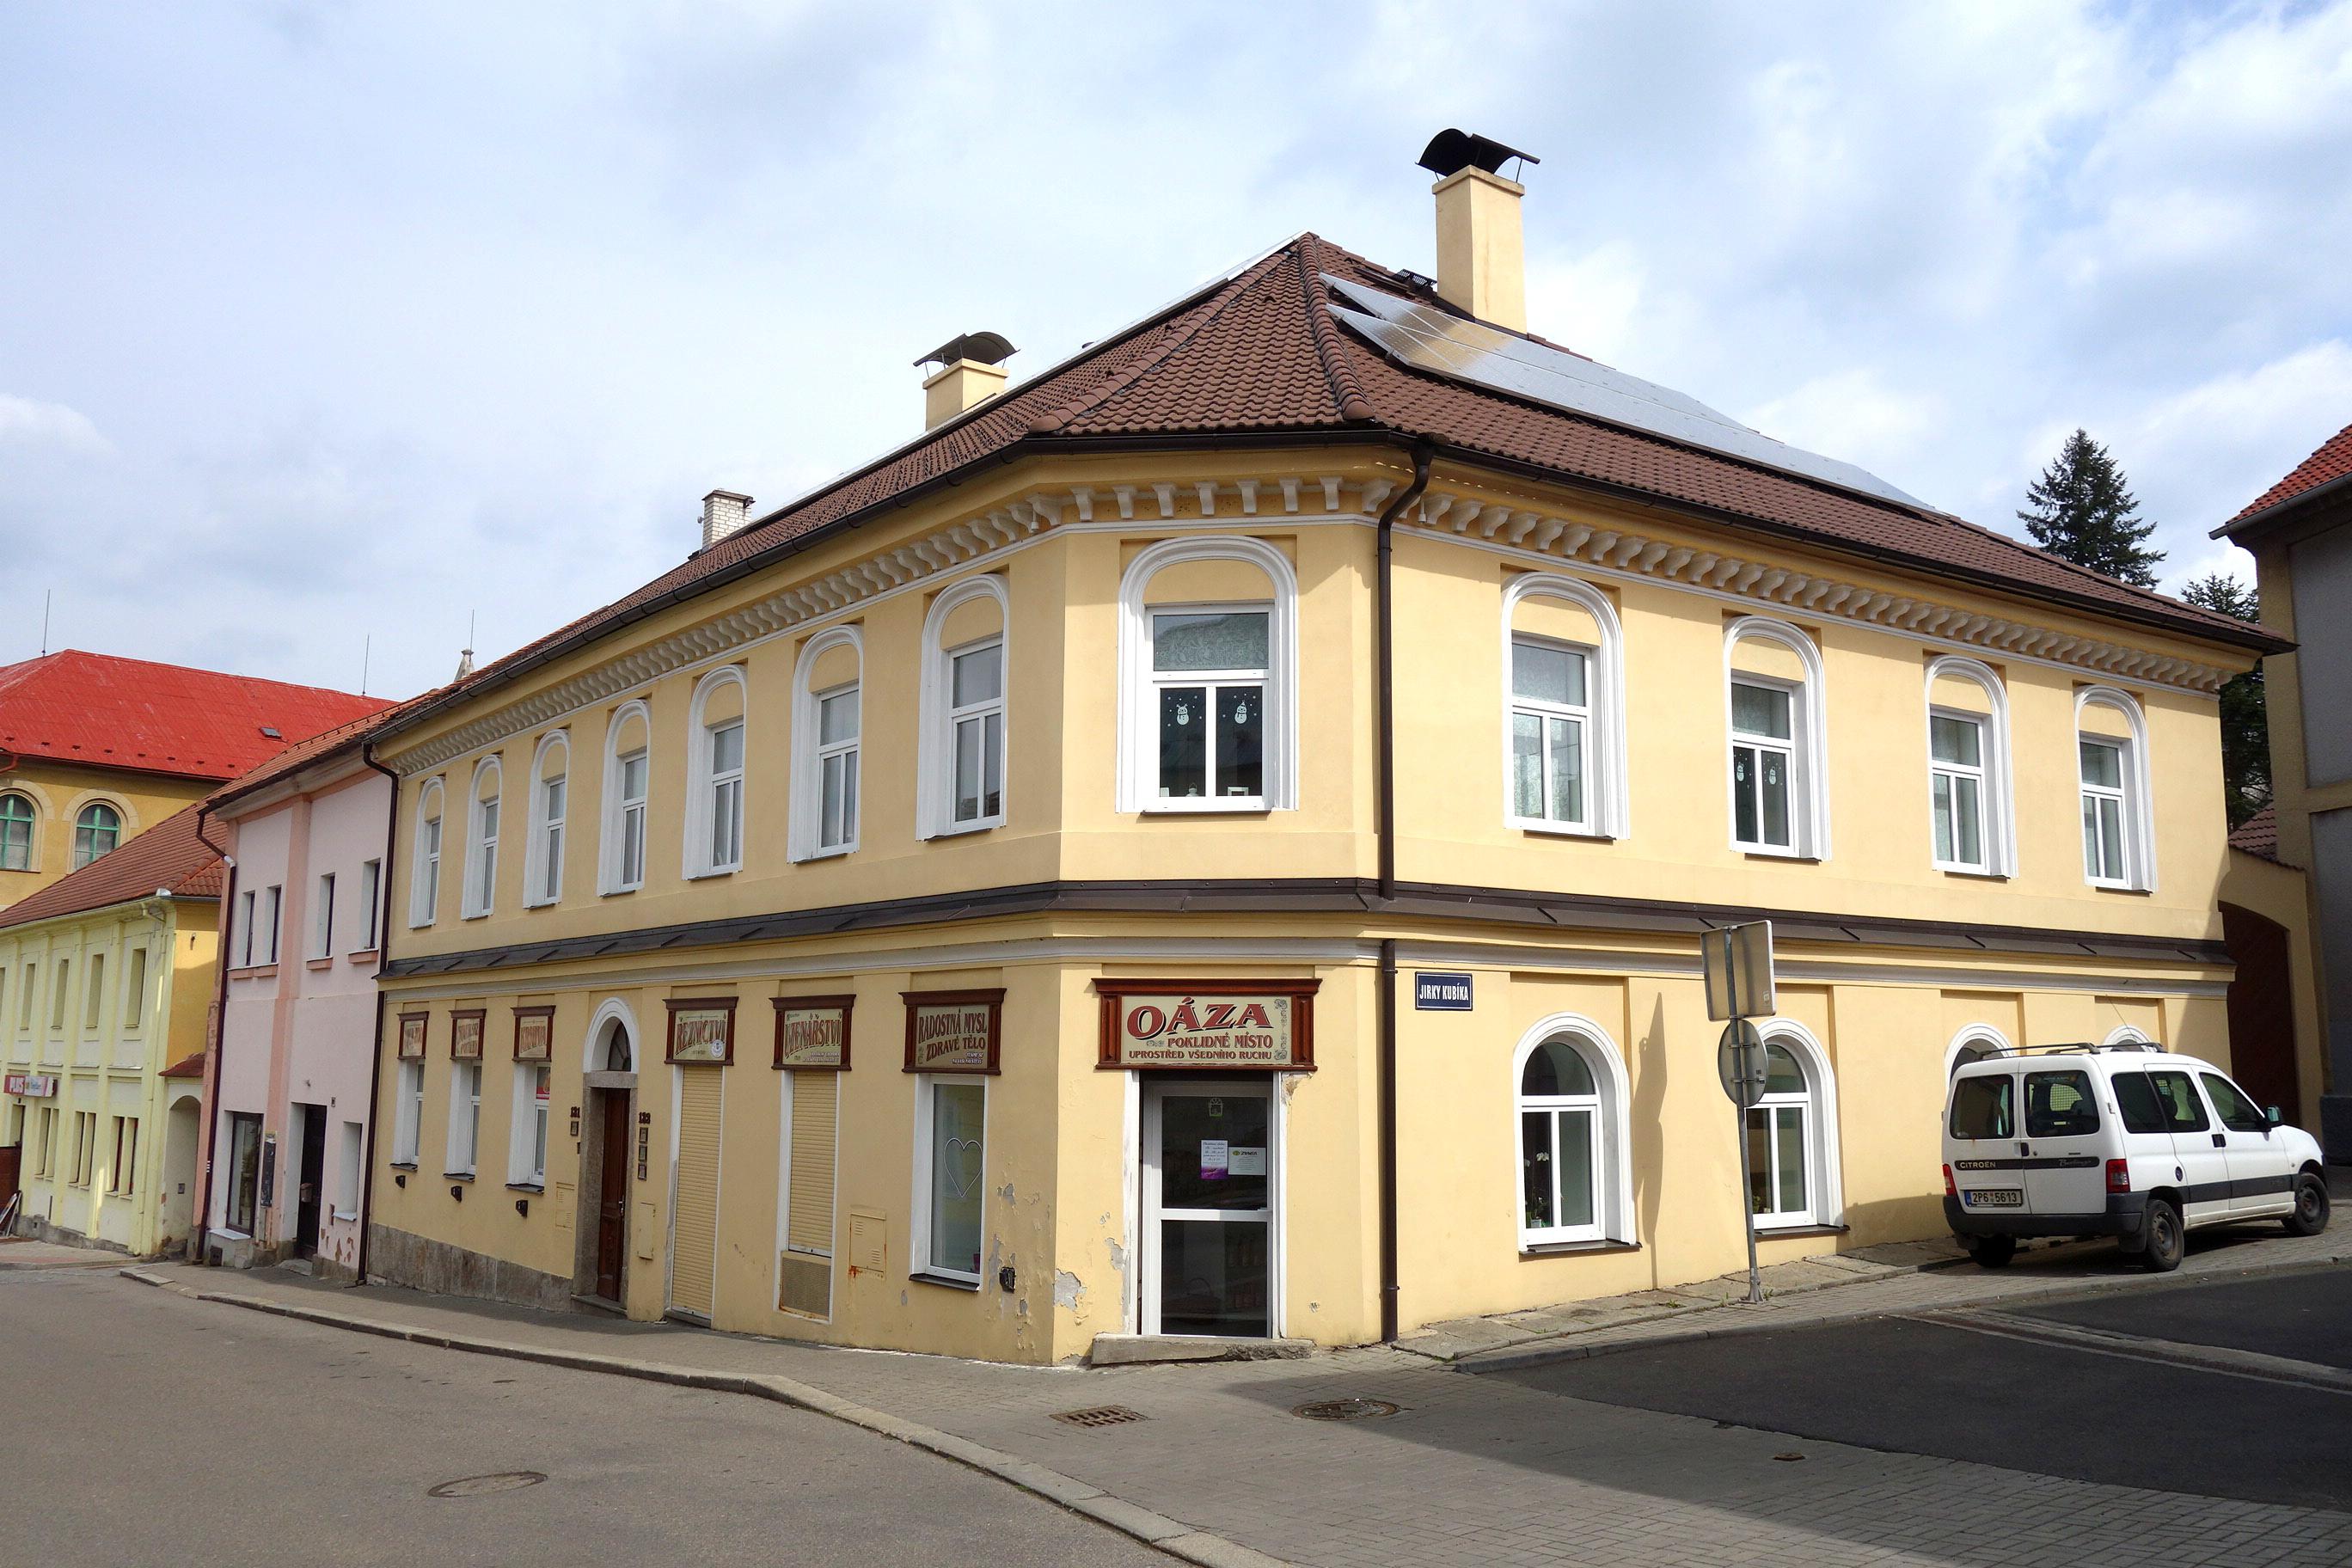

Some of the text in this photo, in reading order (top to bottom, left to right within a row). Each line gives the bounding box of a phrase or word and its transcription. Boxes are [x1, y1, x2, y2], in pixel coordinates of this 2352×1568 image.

[1419, 983, 1469, 1001] JIRKY KUBÍKA
[918, 1008, 988, 1044] RADOSTNÁ MYSL
[1127, 996, 1274, 1040] OÁZA
[926, 1034, 986, 1063] ZDRAVÉ TĚLO
[1167, 1032, 1274, 1049] POKLIDNÉ MÍSTO
[1129, 1049, 1272, 1060] UPROSTŘED VŠEDNÍHO RUCHU
[1973, 1192, 1989, 1203] 2P6
[1995, 1192, 2017, 1203] 5613
